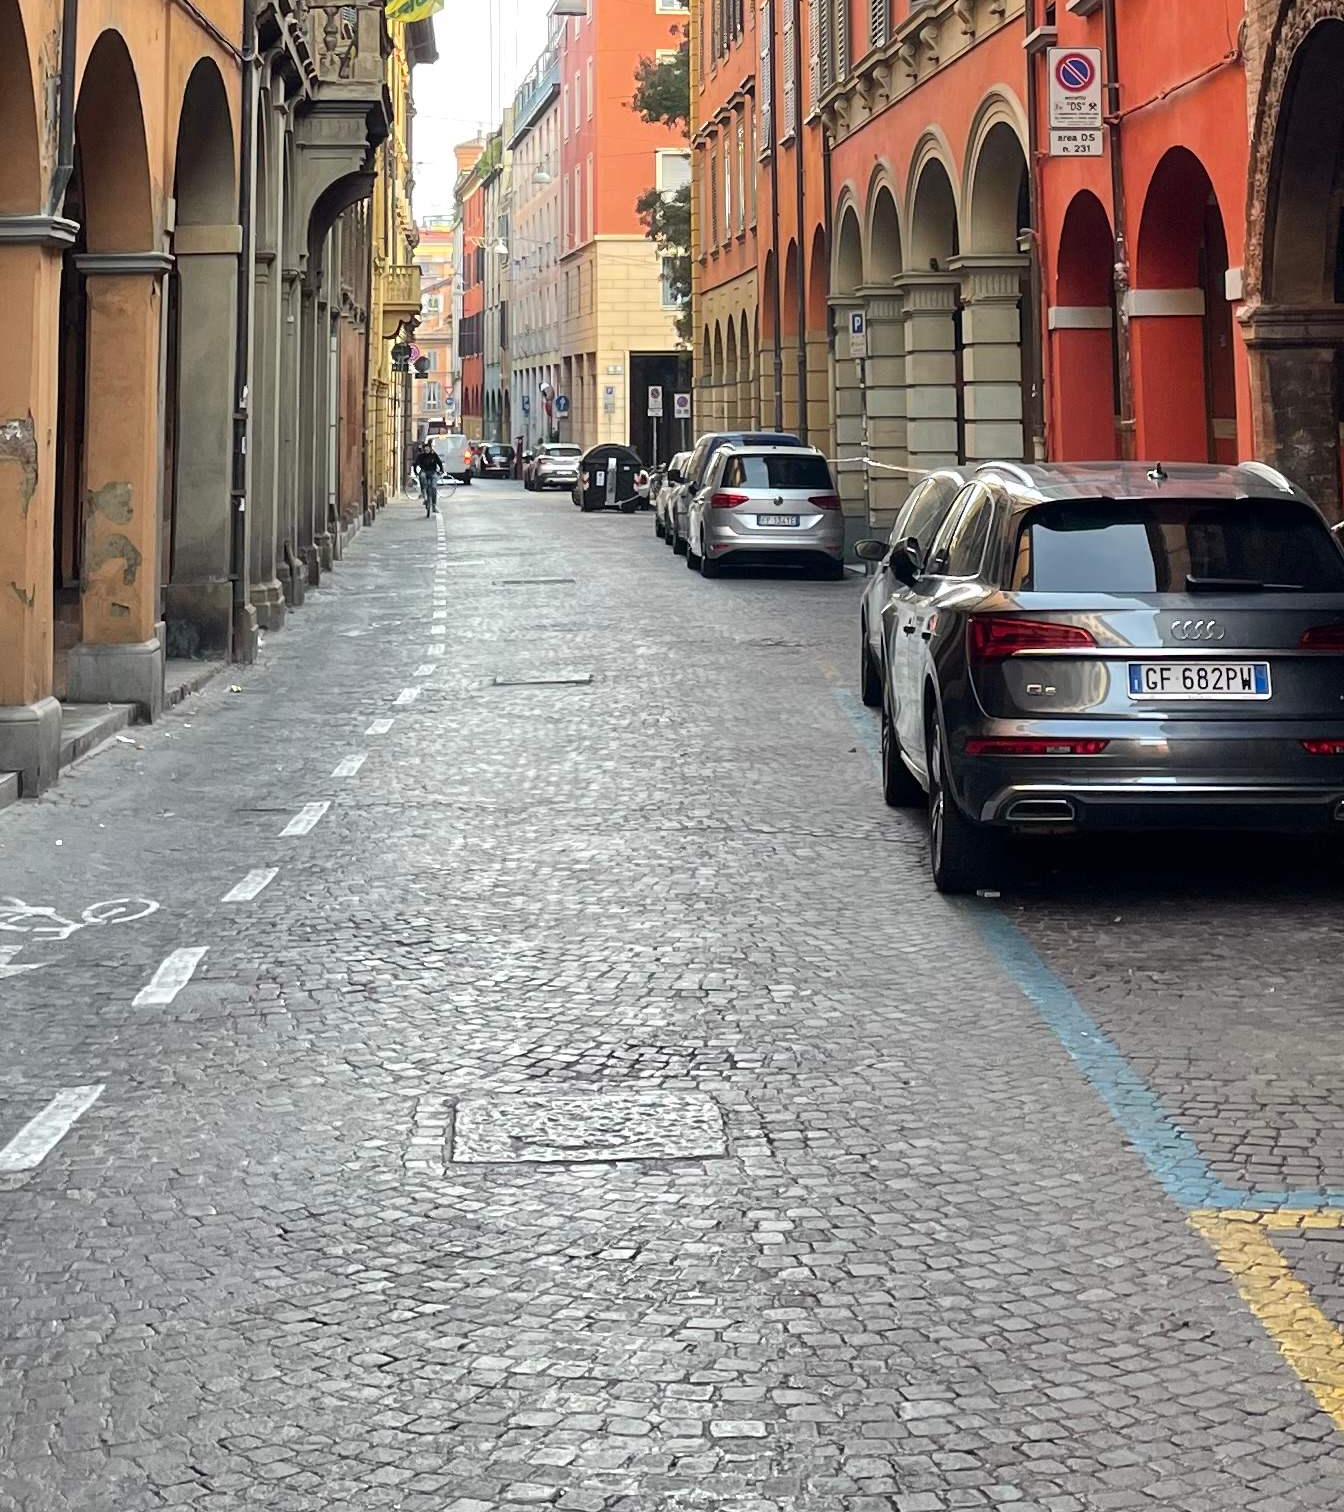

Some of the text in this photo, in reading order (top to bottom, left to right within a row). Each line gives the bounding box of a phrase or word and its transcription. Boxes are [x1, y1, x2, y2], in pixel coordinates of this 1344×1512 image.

[1081, 133, 1096, 142] DS
[1074, 144, 1091, 153] 231
[1145, 666, 1252, 691] GF 682PW
